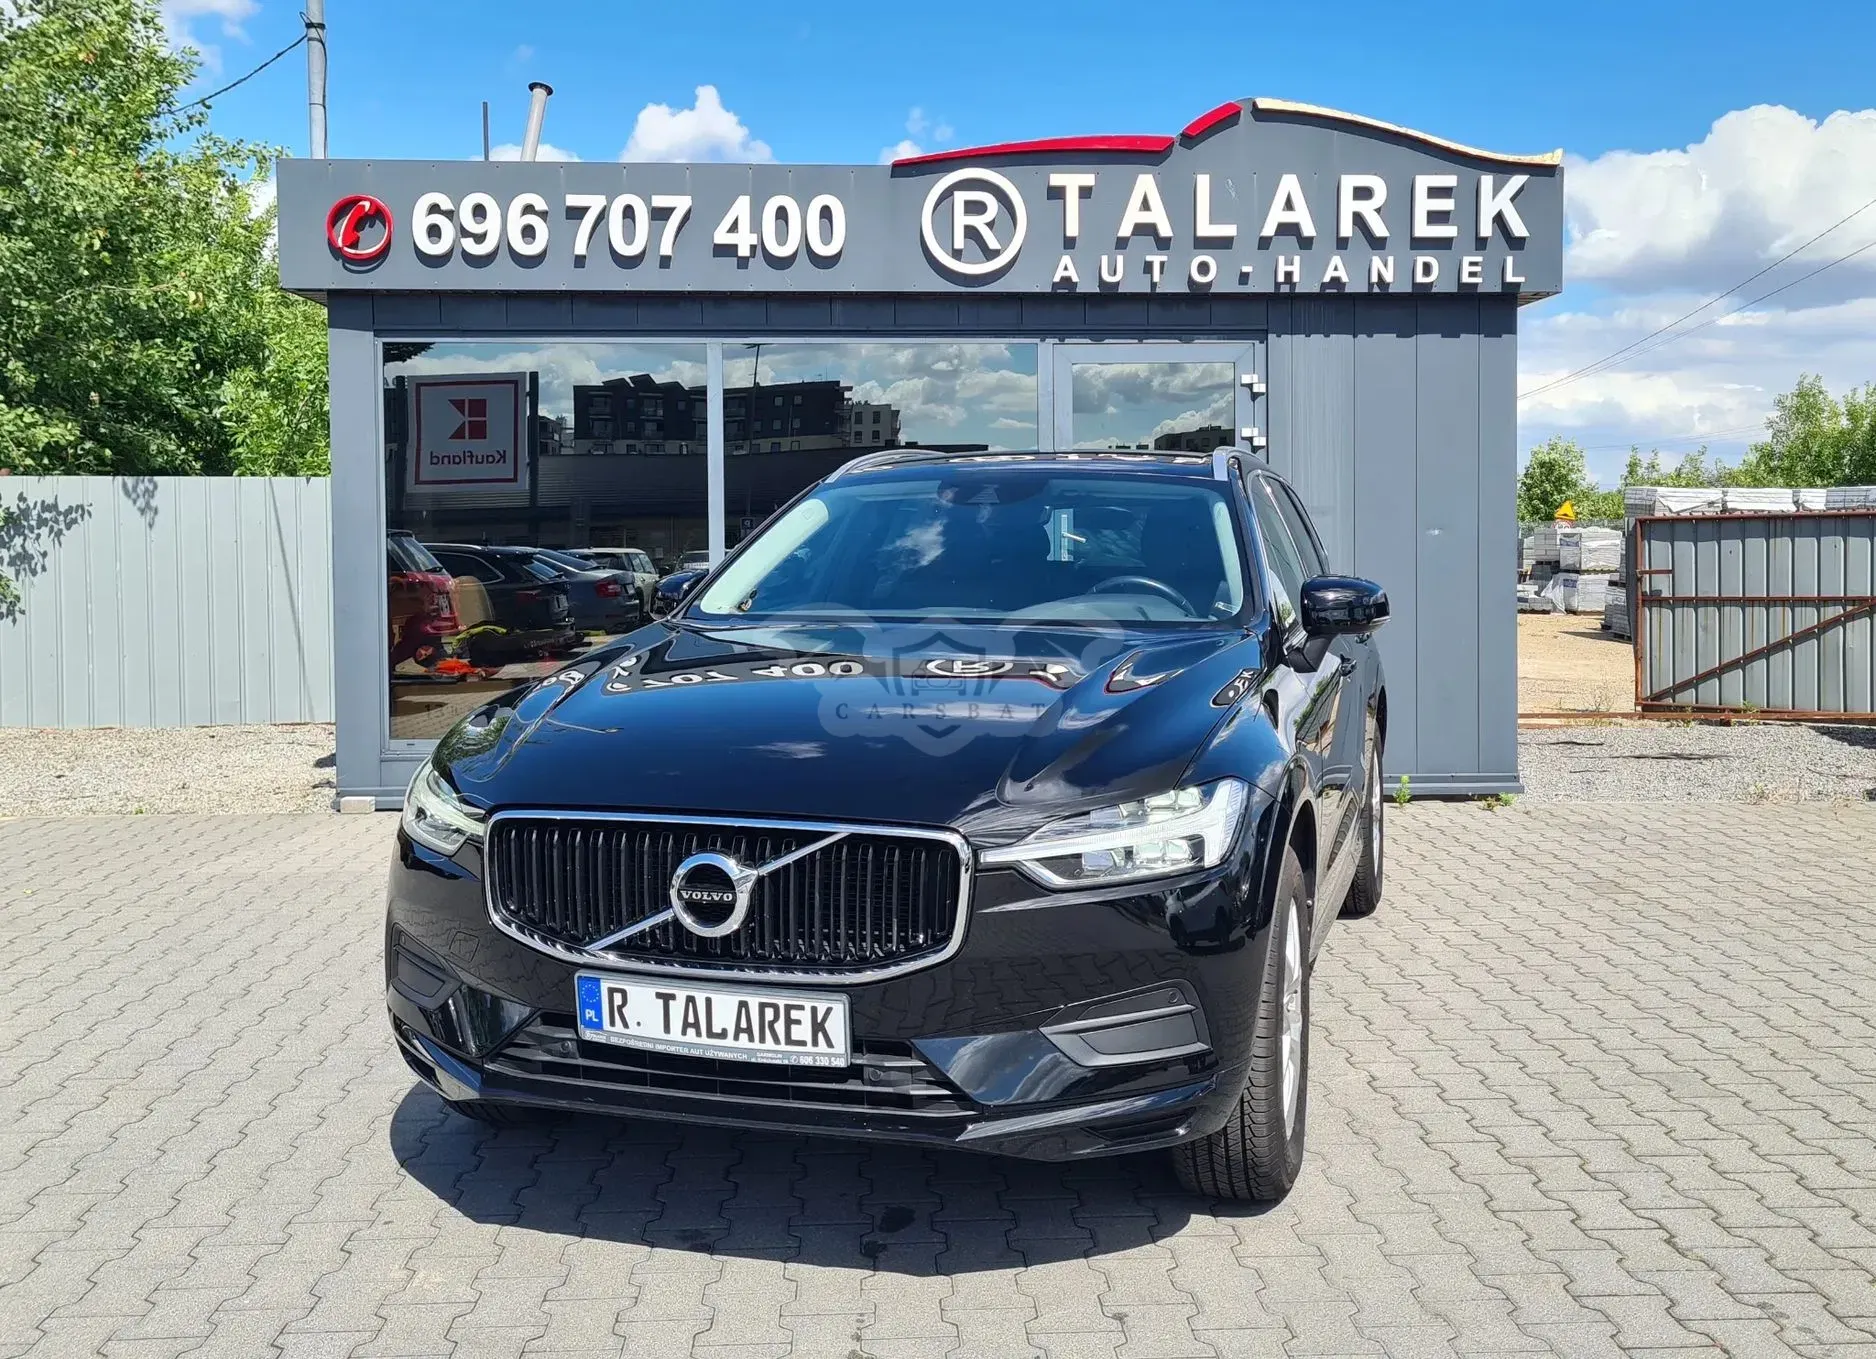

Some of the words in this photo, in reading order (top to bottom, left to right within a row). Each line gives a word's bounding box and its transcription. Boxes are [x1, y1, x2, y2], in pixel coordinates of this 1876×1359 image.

[1048, 173, 1530, 239] TALAREK
[411, 192, 550, 257] 696
[565, 194, 692, 257] 707
[713, 194, 847, 258] 400
[1052, 254, 1526, 284] AUTO-HANDEL
[680, 890, 733, 902] VOLVO
[585, 1010, 599, 1023] PL
[606, 986, 642, 1030] R.
[654, 991, 836, 1049] TALAREK
[655, 1043, 690, 1054] IMPORTER
[690, 1048, 703, 1056] AUT
